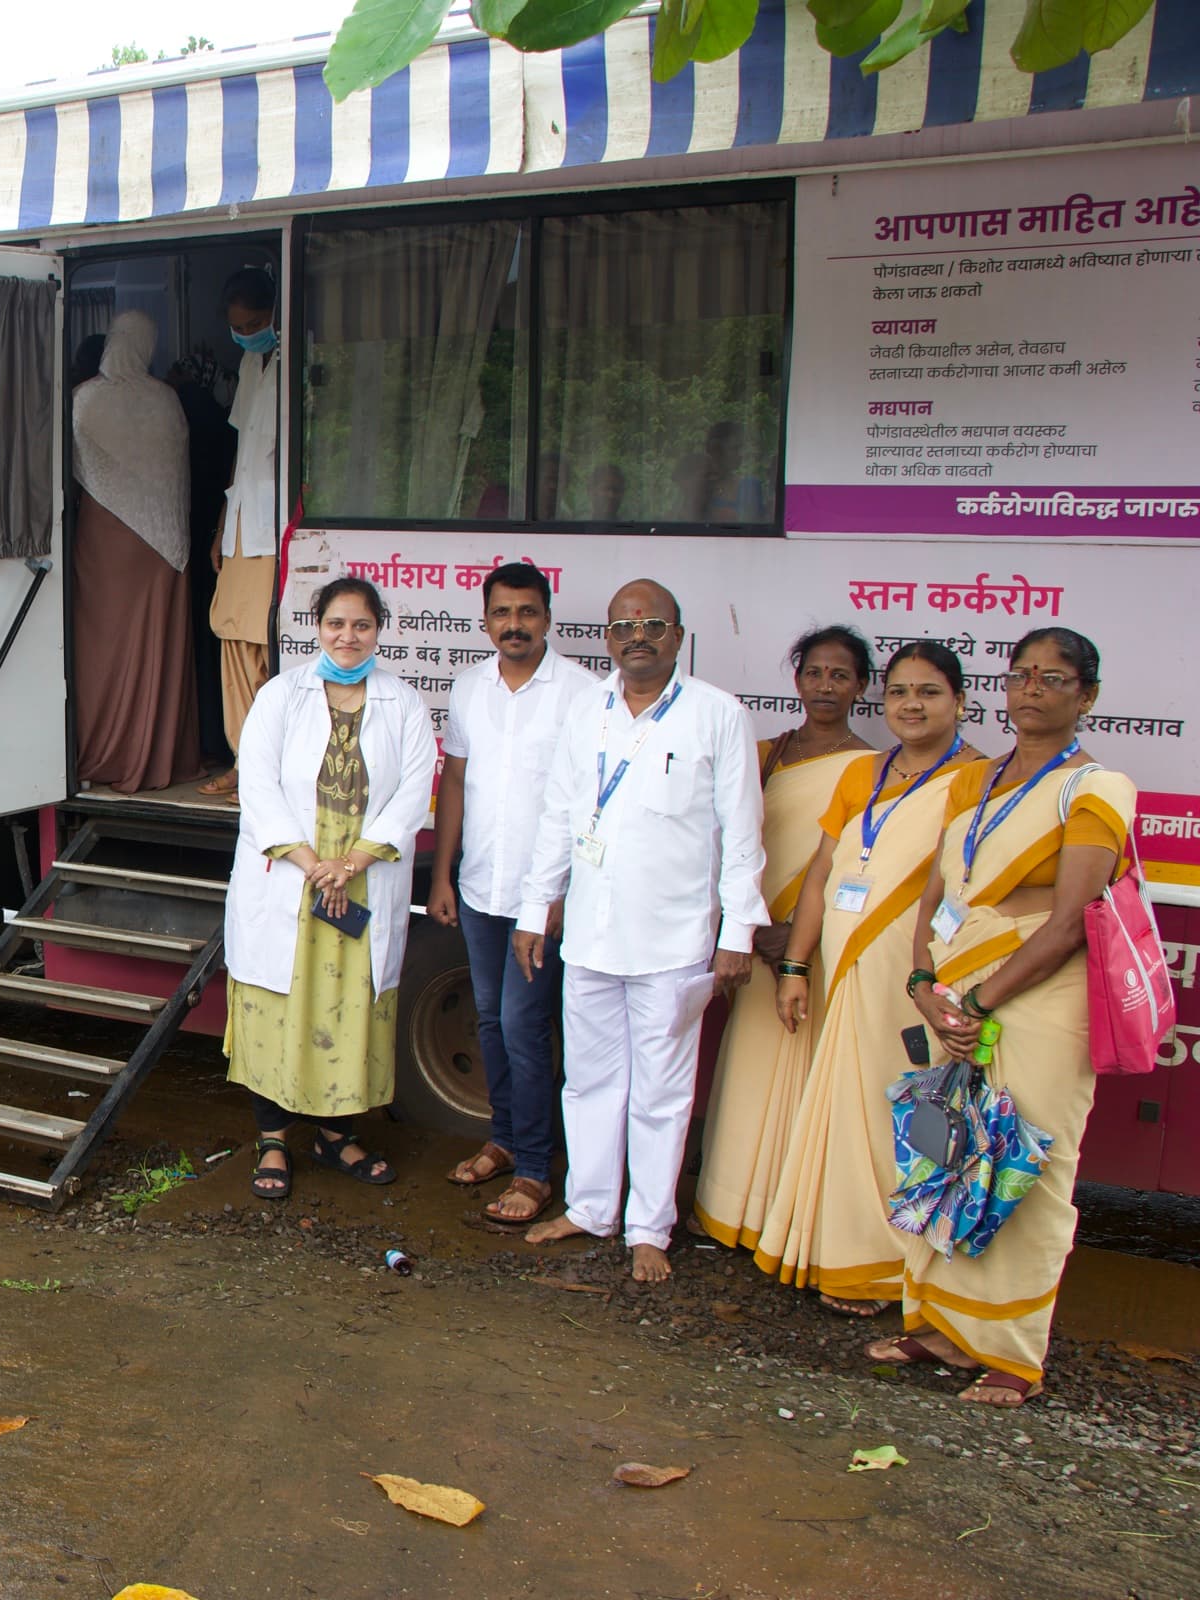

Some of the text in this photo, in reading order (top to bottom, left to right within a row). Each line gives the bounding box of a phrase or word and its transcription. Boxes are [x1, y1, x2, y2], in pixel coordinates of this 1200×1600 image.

[874, 208, 1011, 241] आपणास
[1018, 193, 1126, 235] माहित
[958, 257, 1004, 276] किशोर
[872, 281, 983, 301] केला जाऊ शकतो
[871, 318, 937, 335] व्यायाम
[908, 341, 971, 359] क्रियाशील
[868, 359, 1128, 381] स्तनाच्या कर्करोगाचा आजार कमी असेल
[868, 400, 933, 417] मद्यपान
[961, 424, 1010, 438] मद्यपान
[865, 442, 1098, 459] झाल्यावर स्तनाच्या कर्करोग होण्याचा
[865, 461, 993, 477] धोका अधिक वाढवतो
[956, 491, 1200, 520] कर्करोगाविरुद्ध जागरु
[849, 573, 1064, 617] स्तन कर्करोग
[398, 610, 473, 633] व्यतिरिक्त
[416, 640, 441, 665] बंद
